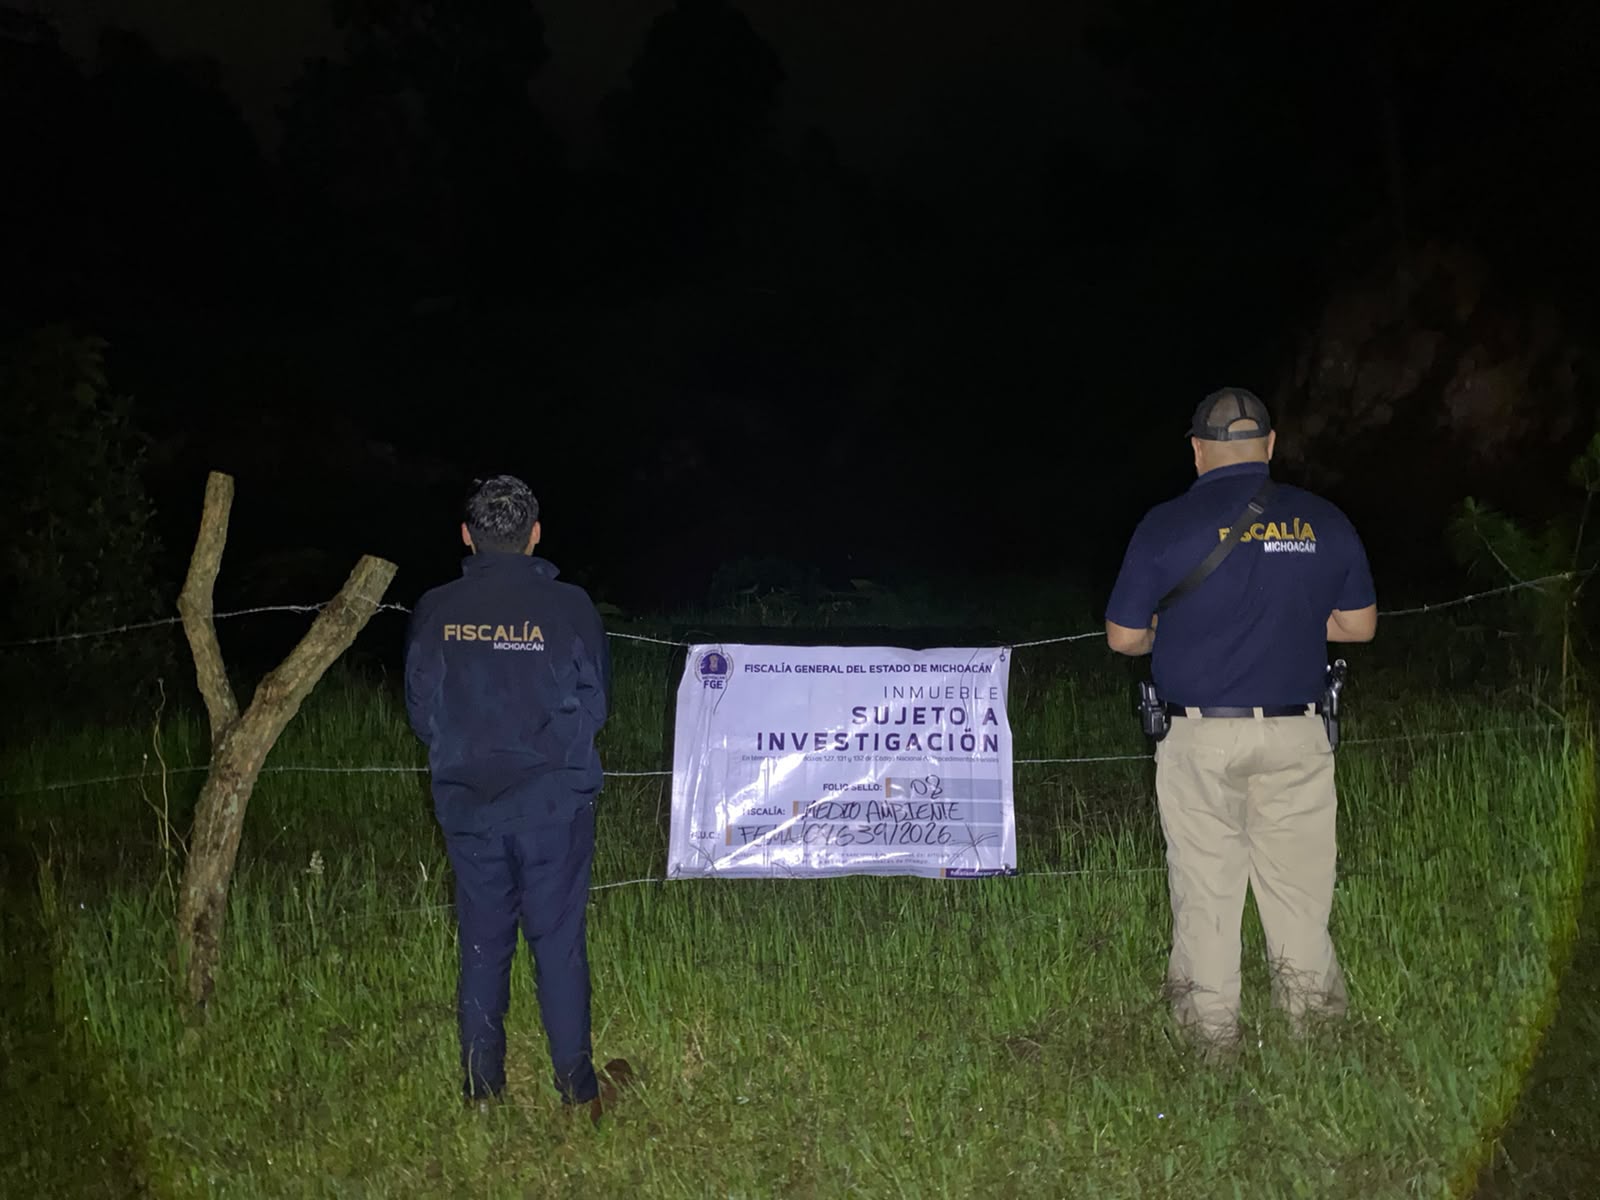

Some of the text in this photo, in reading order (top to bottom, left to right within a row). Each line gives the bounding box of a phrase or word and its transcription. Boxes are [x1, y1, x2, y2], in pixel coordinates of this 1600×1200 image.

[1264, 540, 1316, 553] MICHOACÁN
[444, 620, 544, 642] FISCALÍA
[493, 641, 544, 651] MICHOACÁN
[744, 662, 993, 674] FISCALÍA GENERAL DEL ESTADO DE MICHOACÁN
[703, 680, 724, 689] FGE
[884, 685, 998, 700] INMUEBLE
[851, 706, 999, 726] SUJETO A
[757, 728, 999, 753] INVESTIGACIÓN
[823, 783, 849, 792] FOLIO
[801, 799, 965, 824] MEDIO AMBIENTE
